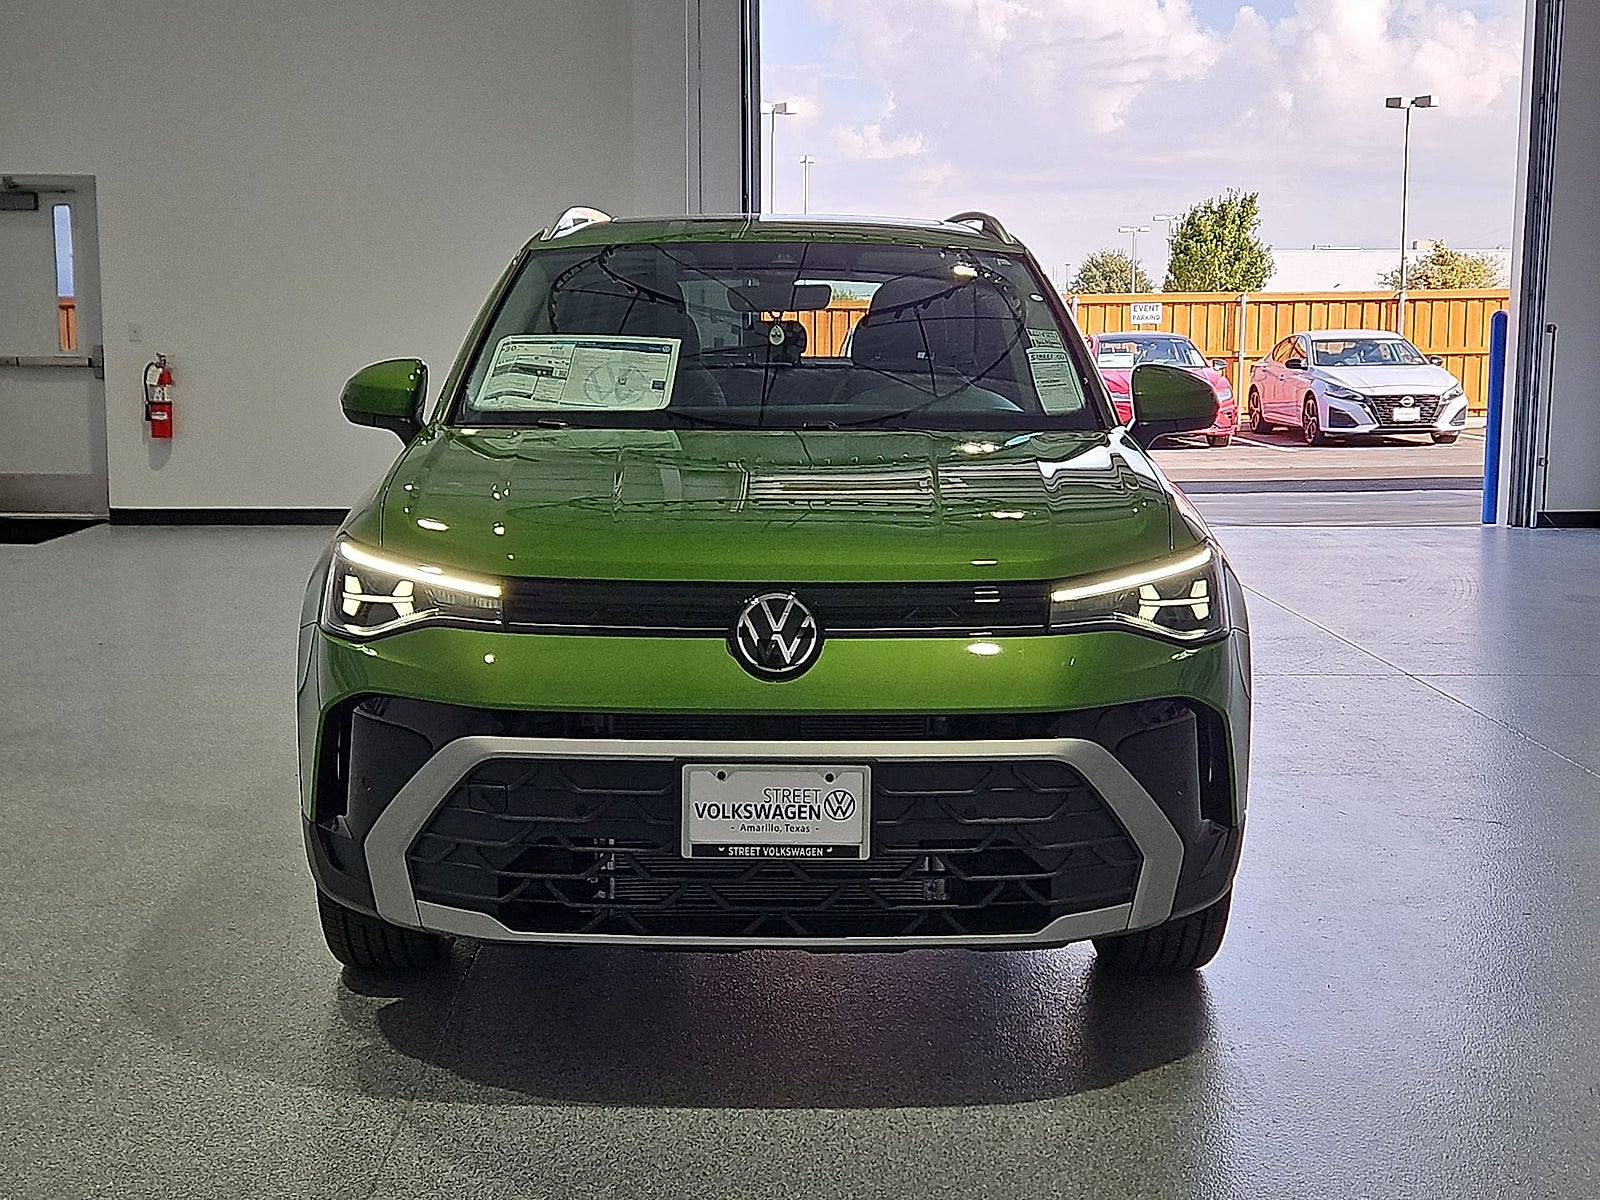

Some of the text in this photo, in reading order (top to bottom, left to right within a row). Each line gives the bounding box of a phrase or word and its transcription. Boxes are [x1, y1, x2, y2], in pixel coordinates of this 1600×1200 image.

[1133, 304, 1160, 312] EVENT
[763, 788, 821, 803] STREET
[694, 803, 821, 820] VOLKSWAGEN
[739, 823, 811, 833] Amarillo, Texas
[728, 846, 823, 856] STREET VOLKSWAGEN
